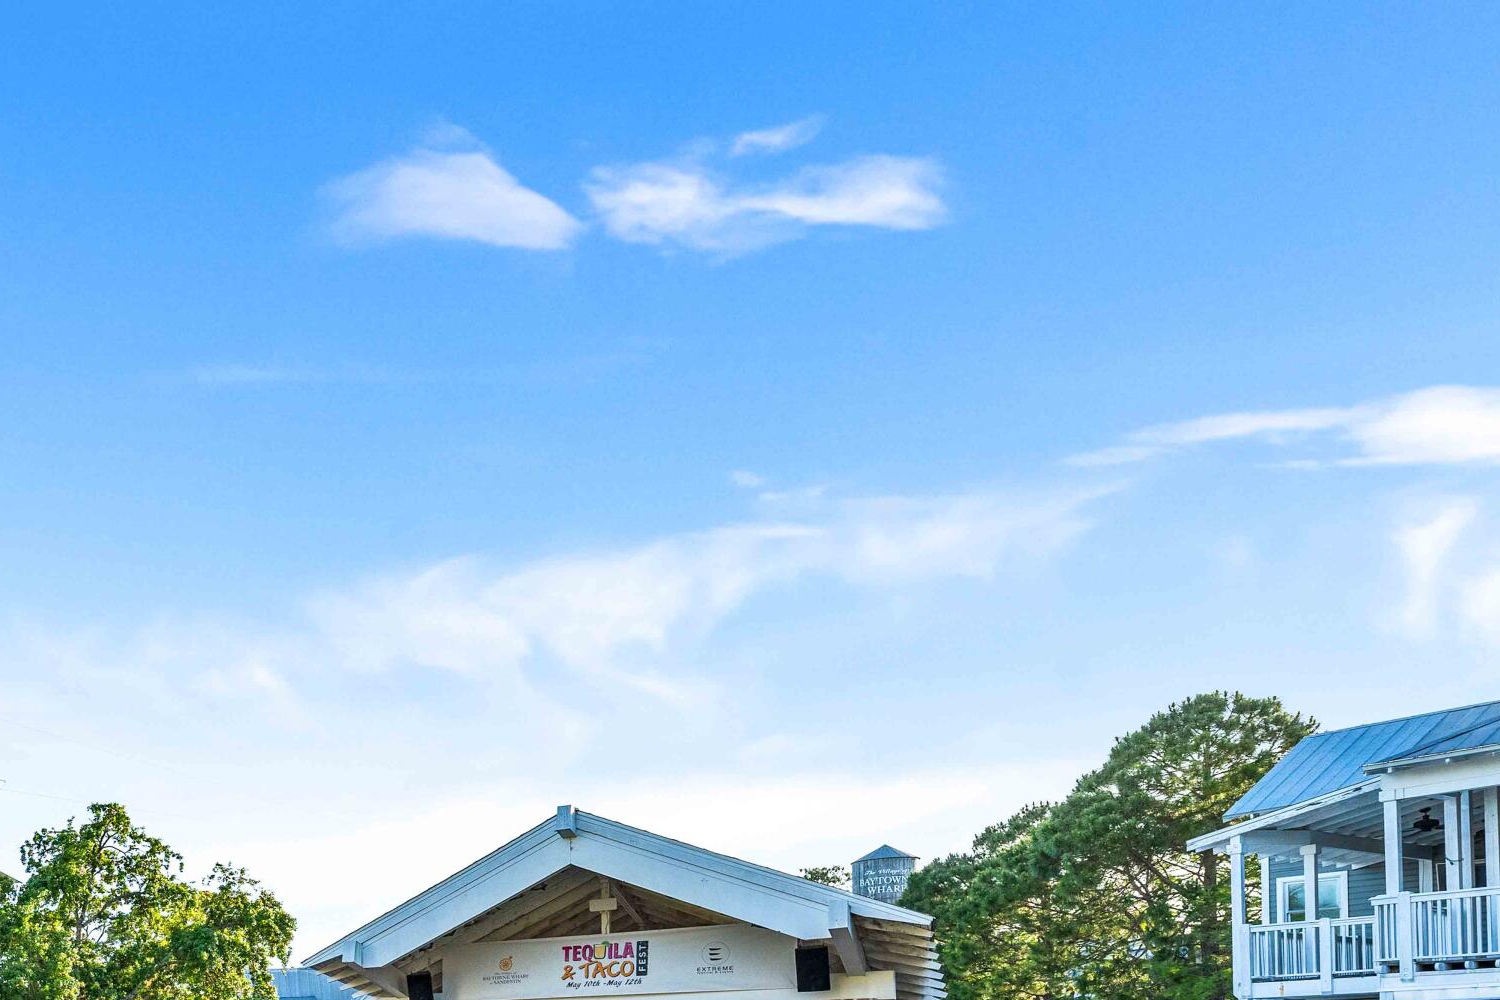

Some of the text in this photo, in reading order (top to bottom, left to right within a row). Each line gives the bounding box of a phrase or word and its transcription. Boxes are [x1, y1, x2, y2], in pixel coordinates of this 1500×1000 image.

[860, 876, 908, 887] BAYTOWN
[562, 941, 635, 962] TEQUILA
[638, 944, 647, 972] FEST
[561, 960, 635, 980] & TACO
[566, 980, 581, 989] May
[625, 978, 642, 986] 12th
